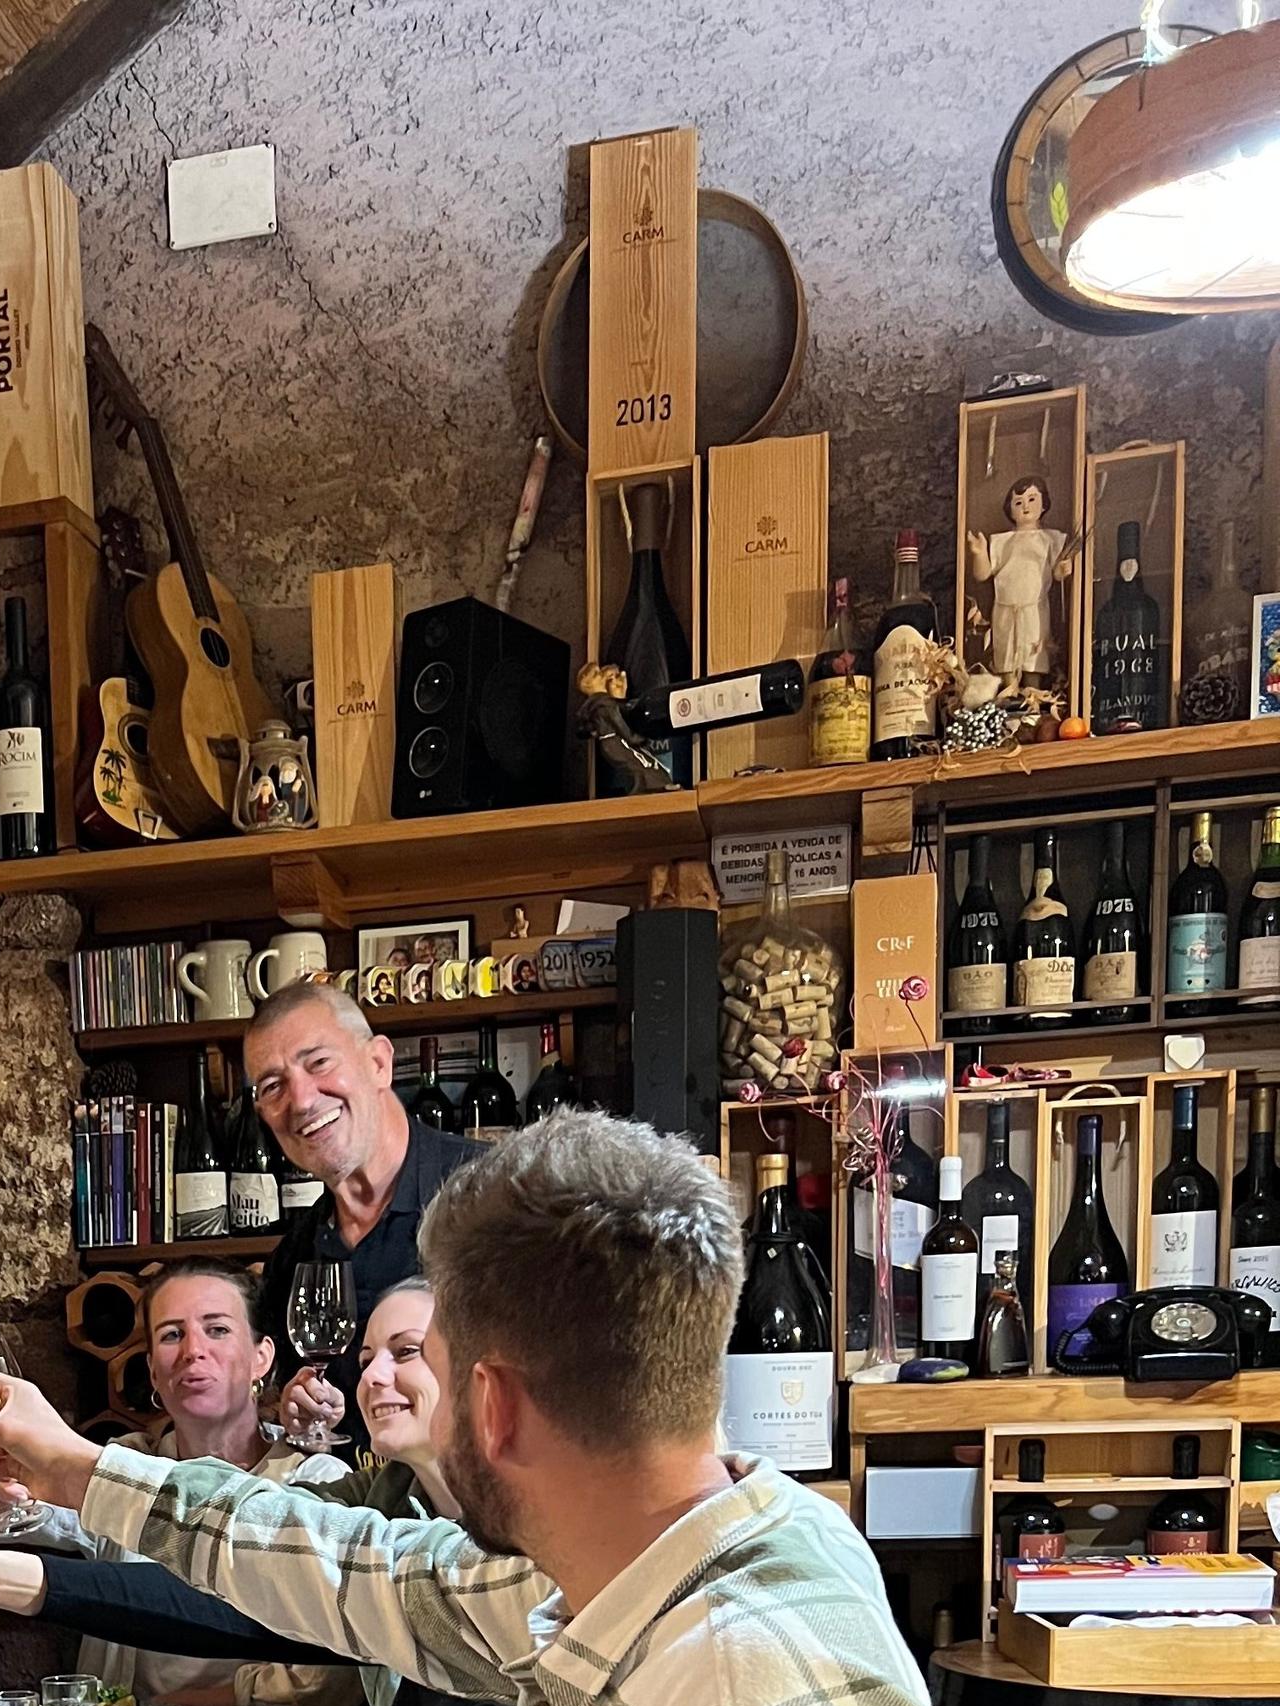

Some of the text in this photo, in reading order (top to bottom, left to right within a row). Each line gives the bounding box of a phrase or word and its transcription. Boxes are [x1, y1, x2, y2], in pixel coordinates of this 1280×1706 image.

[622, 226, 665, 244] CARM
[616, 394, 672, 427] 2013
[745, 537, 788, 553] CARM
[337, 700, 377, 716] CARM
[649, 739, 670, 751] RM
[721, 835, 842, 856] É PROIBIDA A VENDA DE
[721, 857, 764, 870] BEBIDAS
[834, 850, 842, 860] A
[725, 872, 767, 884] MENOR
[794, 868, 805, 878] 16
[808, 865, 837, 877] ANOS
[1095, 898, 1135, 916] 1975
[961, 912, 999, 929] 1975
[580, 950, 616, 969] 1952
[753, 1412, 792, 1420] CORTES
[795, 1411, 808, 1419] DO
